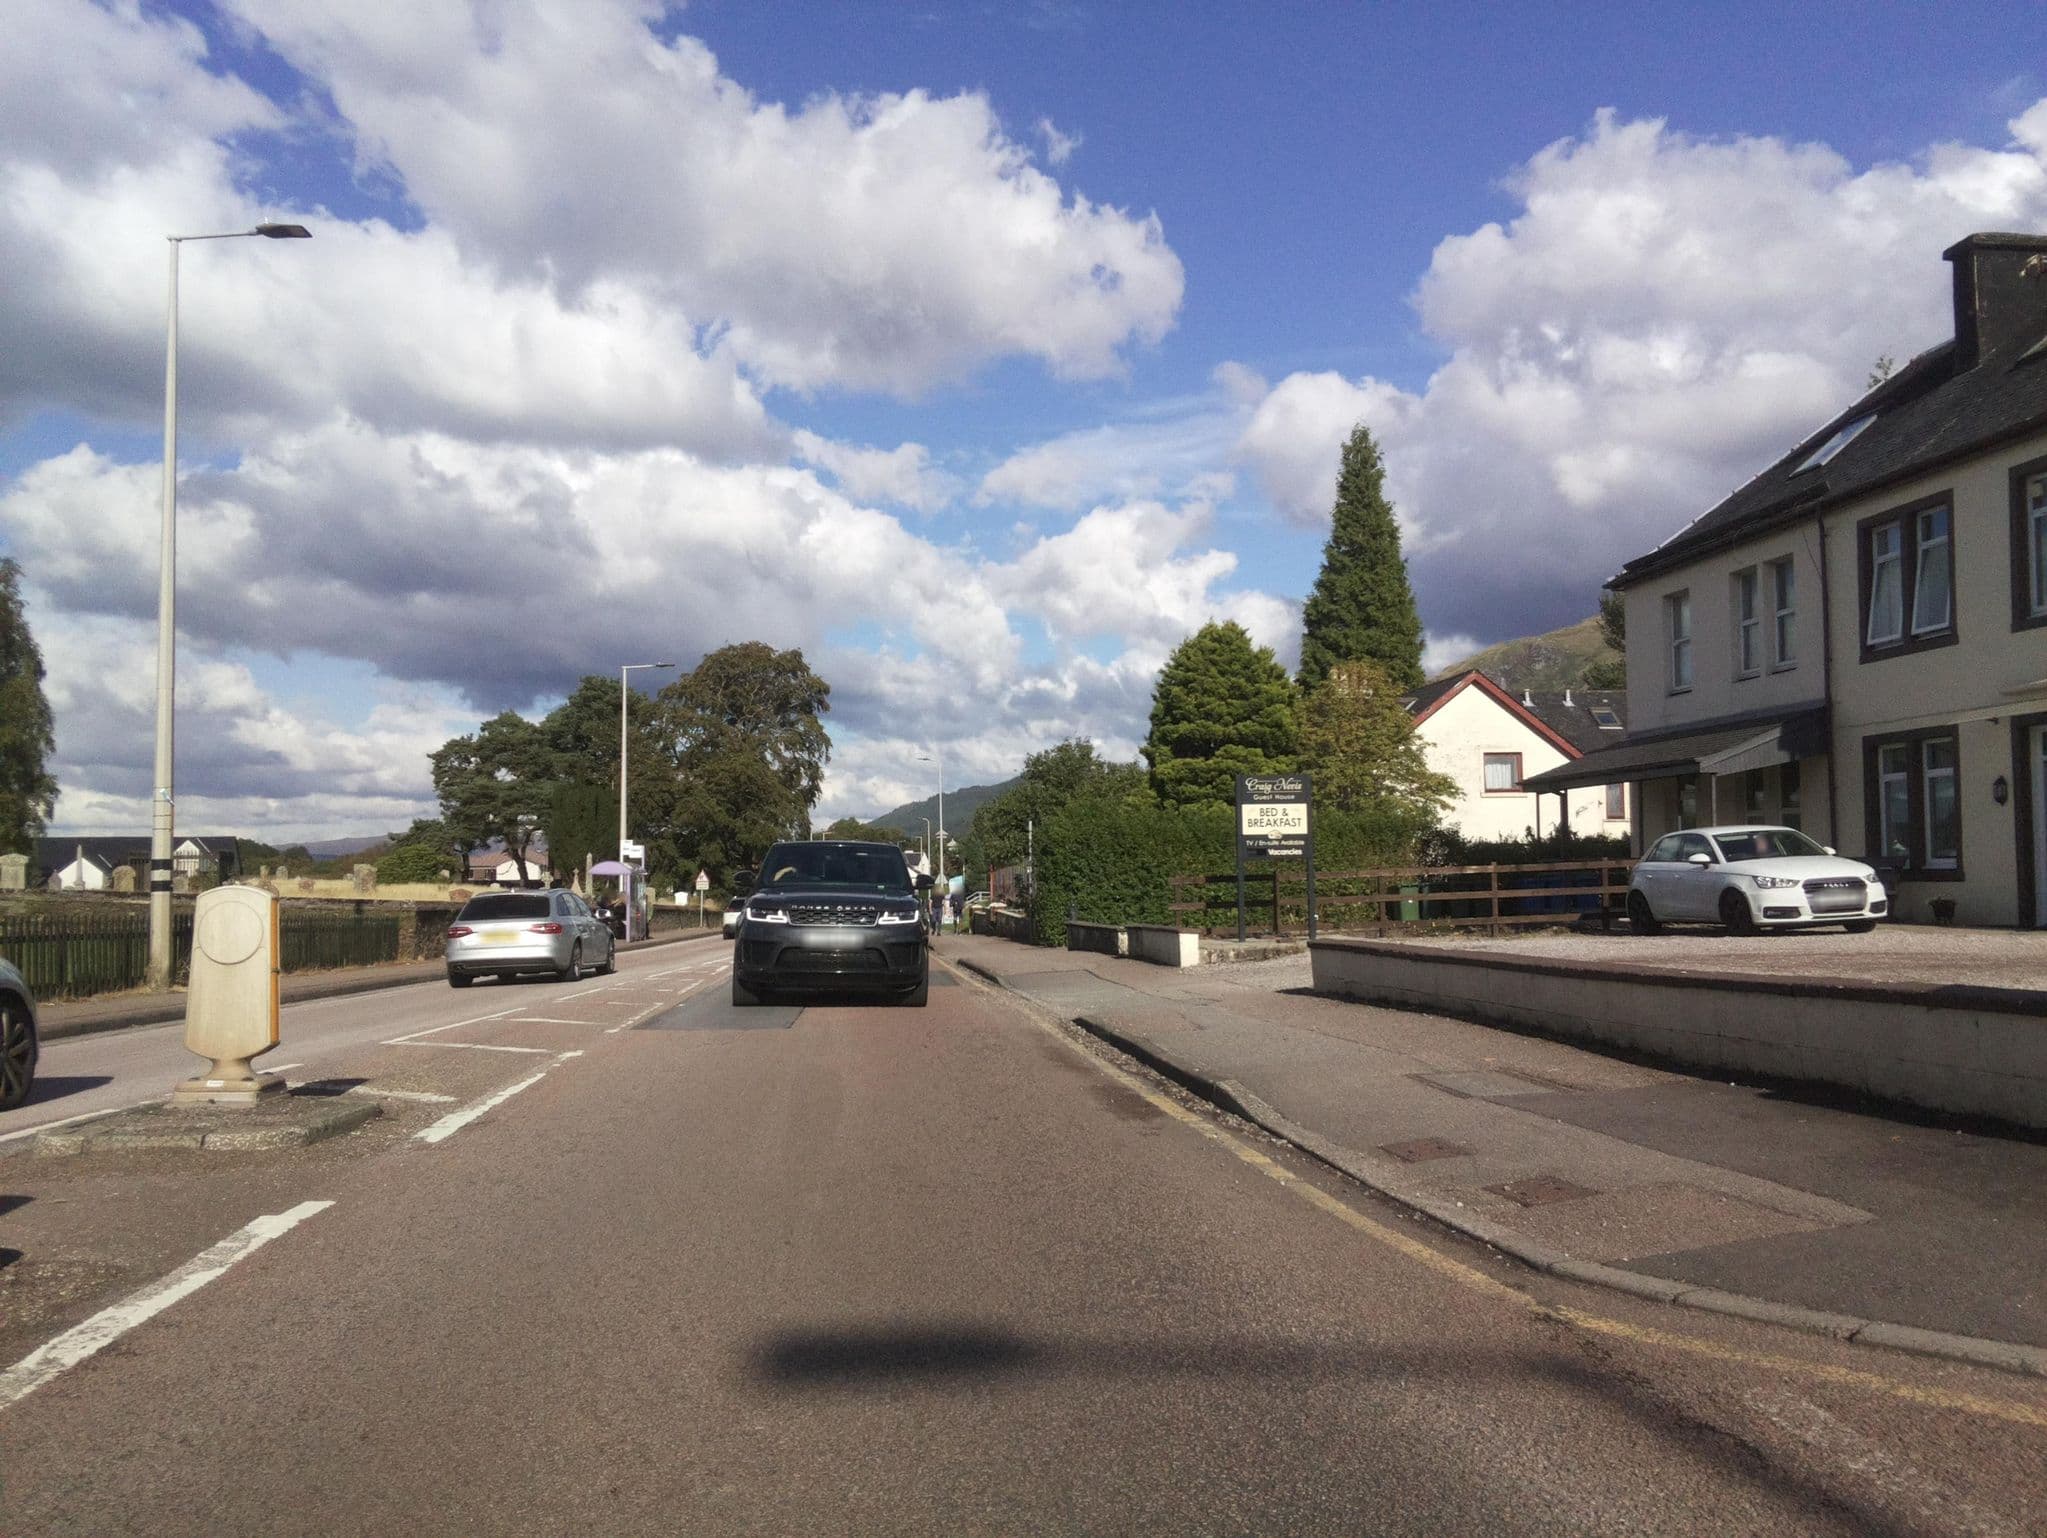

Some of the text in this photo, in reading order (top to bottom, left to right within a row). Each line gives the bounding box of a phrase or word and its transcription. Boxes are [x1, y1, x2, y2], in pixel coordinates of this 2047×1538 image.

[1245, 777, 1302, 794] Craig Nevis
[1259, 808, 1289, 817] BED &
[1248, 818, 1302, 828] BREAKFAST
